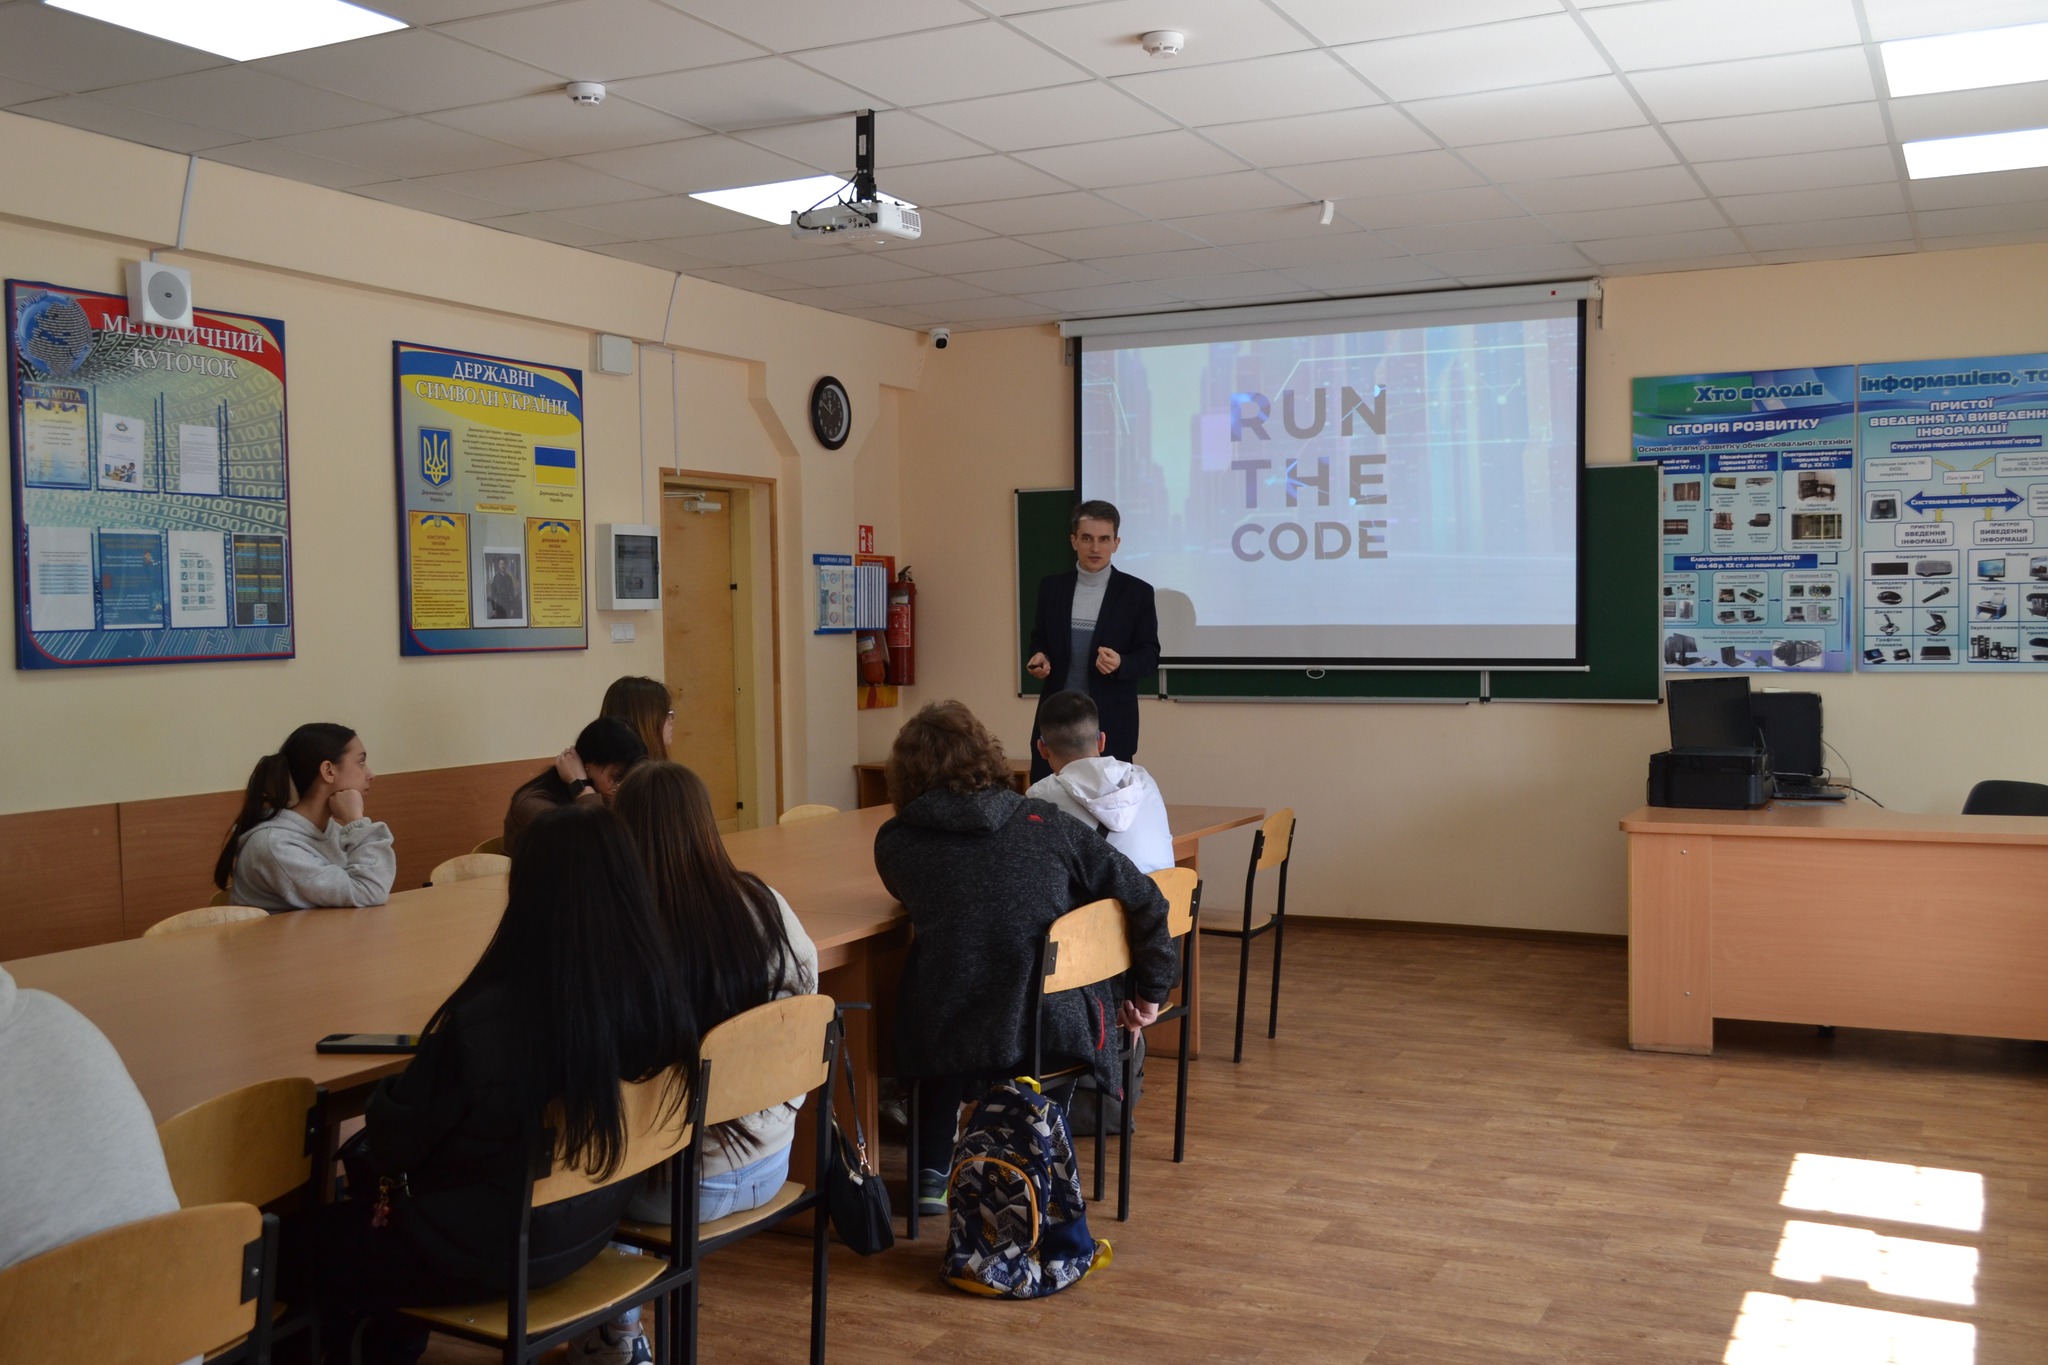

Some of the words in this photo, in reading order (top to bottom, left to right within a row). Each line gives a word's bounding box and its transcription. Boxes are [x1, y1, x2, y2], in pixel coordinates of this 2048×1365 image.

[133, 347, 238, 379] КУТОЧОК
[452, 360, 535, 388] ДЕРЖАВНІ
[1861, 370, 2020, 394] інформацією,
[31, 387, 81, 400] ГРАМОТА
[415, 380, 499, 407] СИМВОЛИ
[502, 392, 569, 416] УКРАЇНИ
[1694, 385, 1738, 402] Хто
[1740, 381, 1824, 400] володіє
[1231, 384, 1386, 442] RUN
[1930, 398, 1994, 412] ПРИСТОЇ
[1668, 422, 1729, 435] ІСТОРІЯ
[1733, 418, 1820, 432] РОЗВИТКУ
[1870, 414, 1944, 427] ВВЕДЕННЯ
[1947, 413, 1965, 423] ТА
[1968, 410, 2048, 422] ВИВЕДЕНН
[1917, 423, 2008, 437] ІНФОРМАЦІЇ
[1638, 445, 1671, 453] Основні
[1932, 440, 1991, 448] персонального
[1231, 454, 1387, 509] THE
[1231, 520, 1388, 562] CODE
